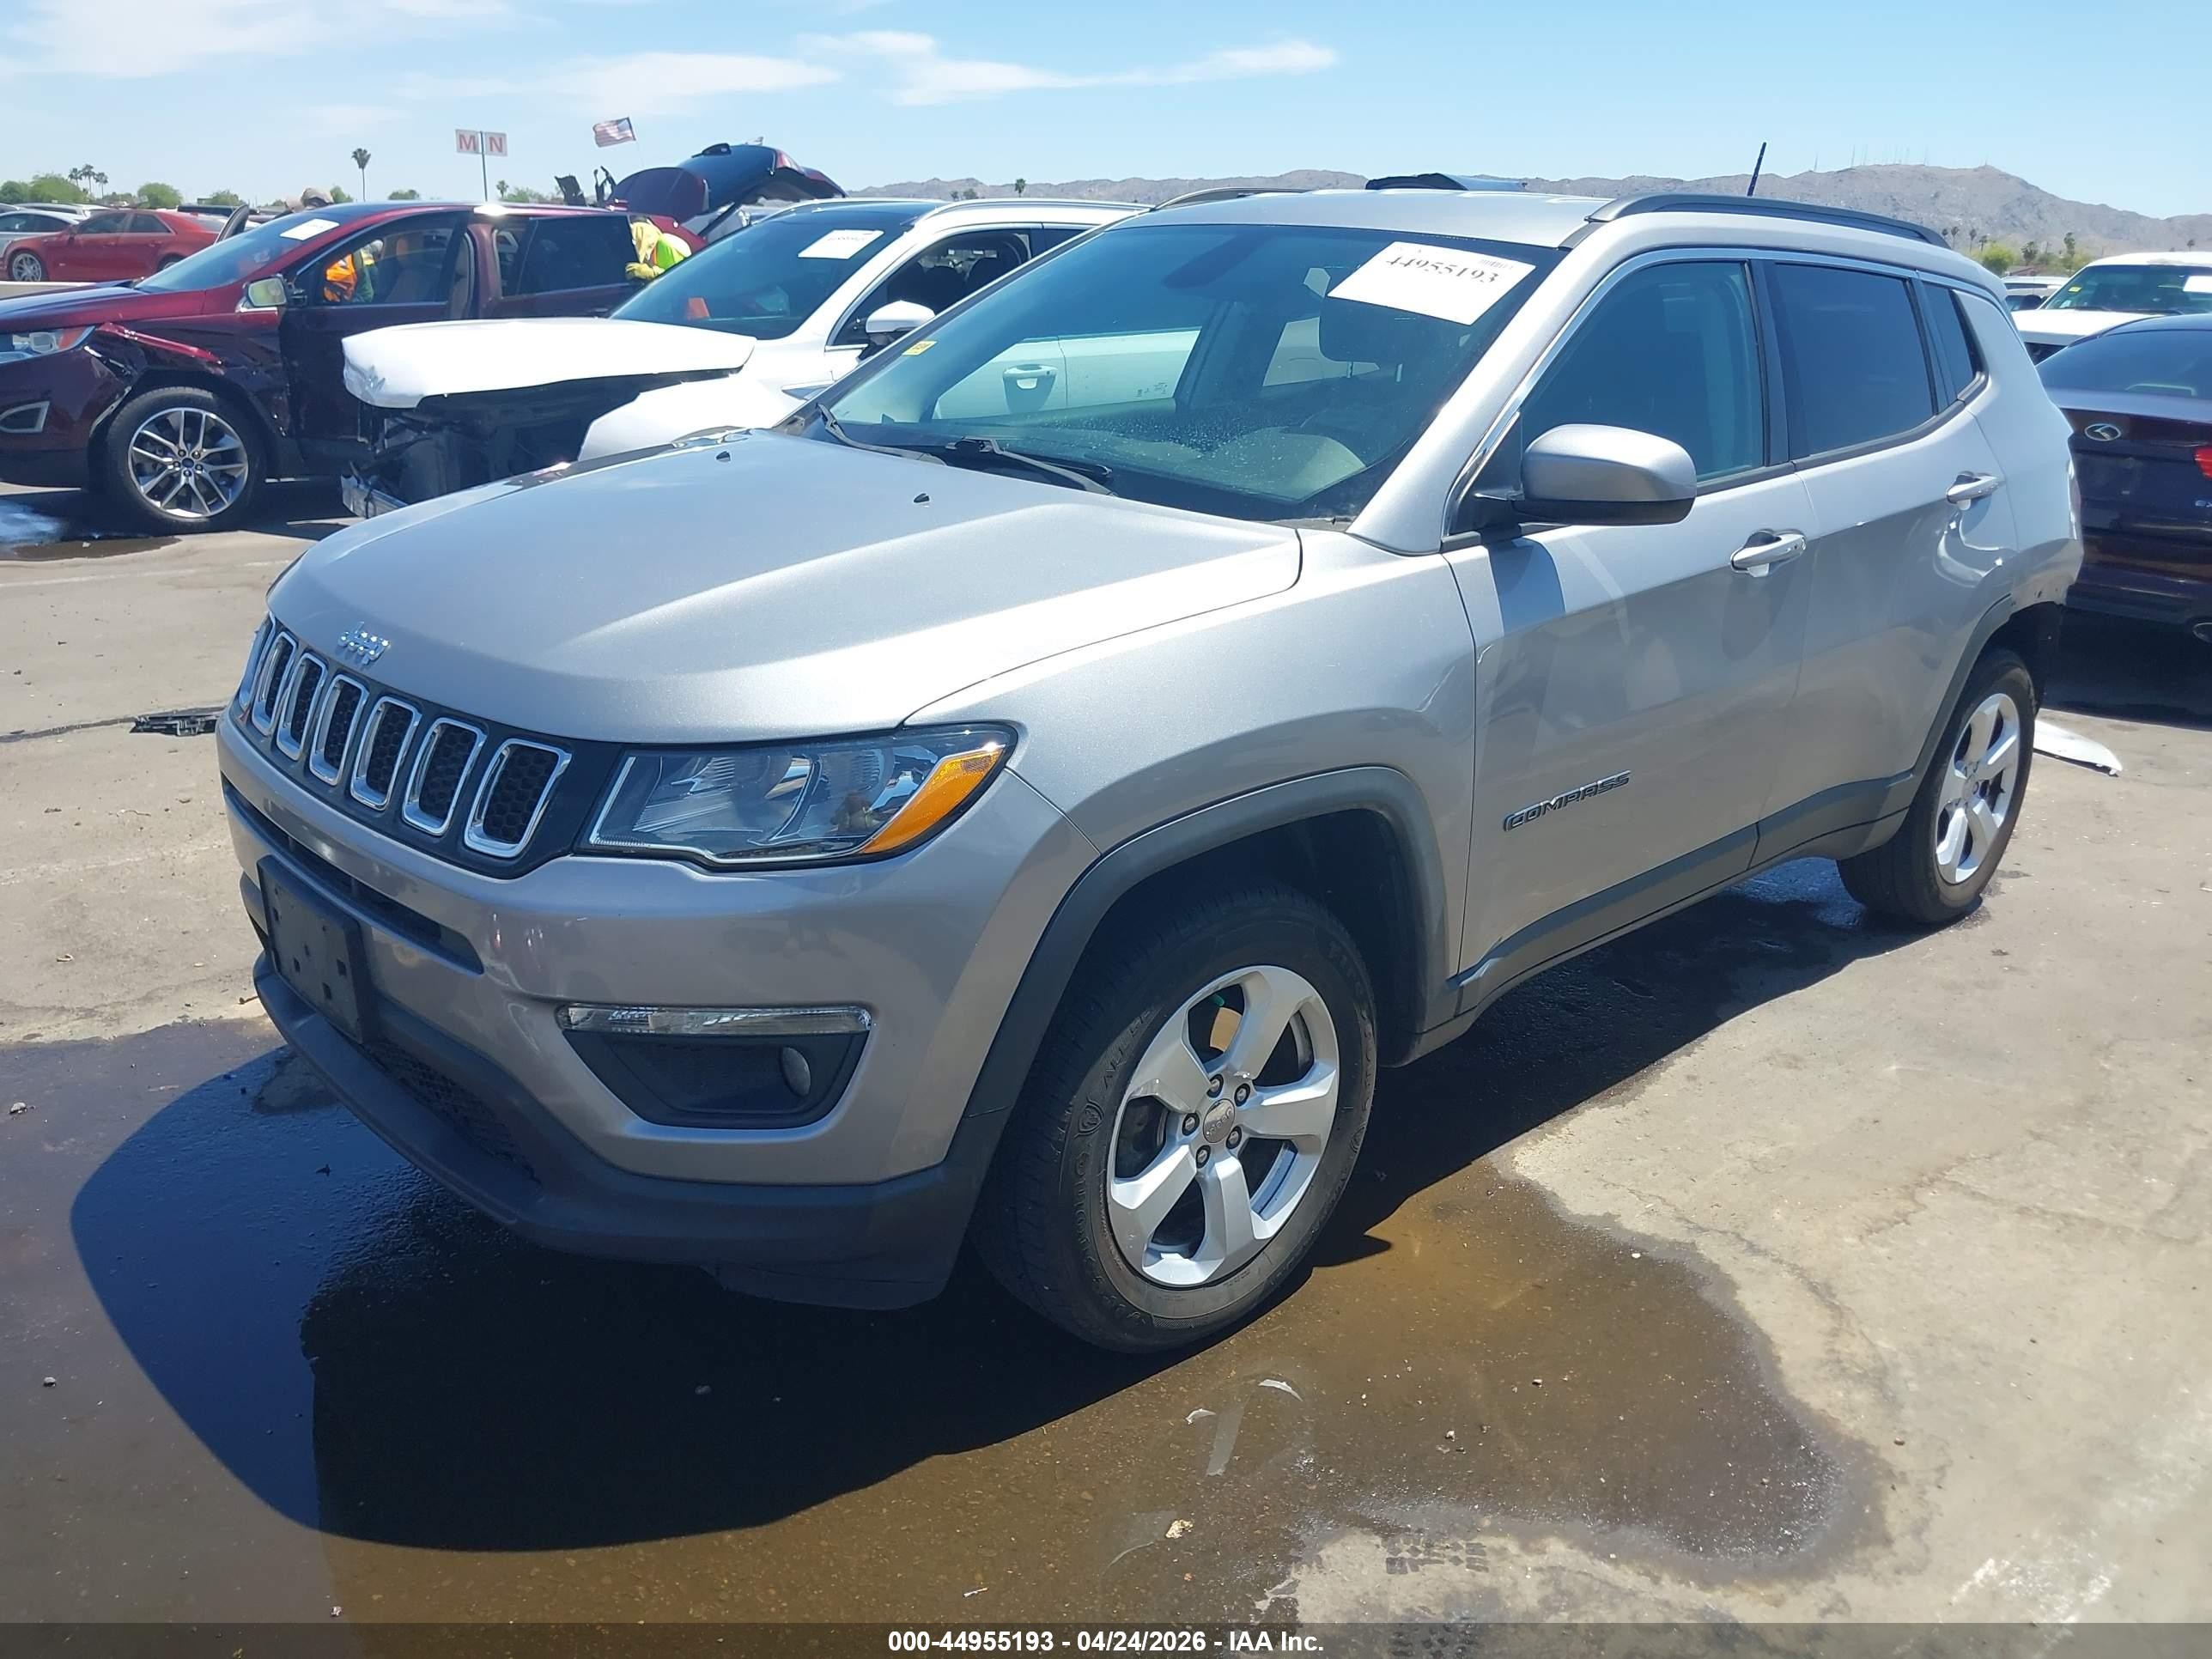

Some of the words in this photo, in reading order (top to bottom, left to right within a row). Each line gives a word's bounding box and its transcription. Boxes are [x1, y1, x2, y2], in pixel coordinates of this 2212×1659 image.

[459, 134, 477, 152] M
[489, 136, 503, 153] N
[1385, 254, 1500, 283] 44955193
[337, 621, 391, 665] Jeep
[1504, 769, 1632, 832] COMPASS
